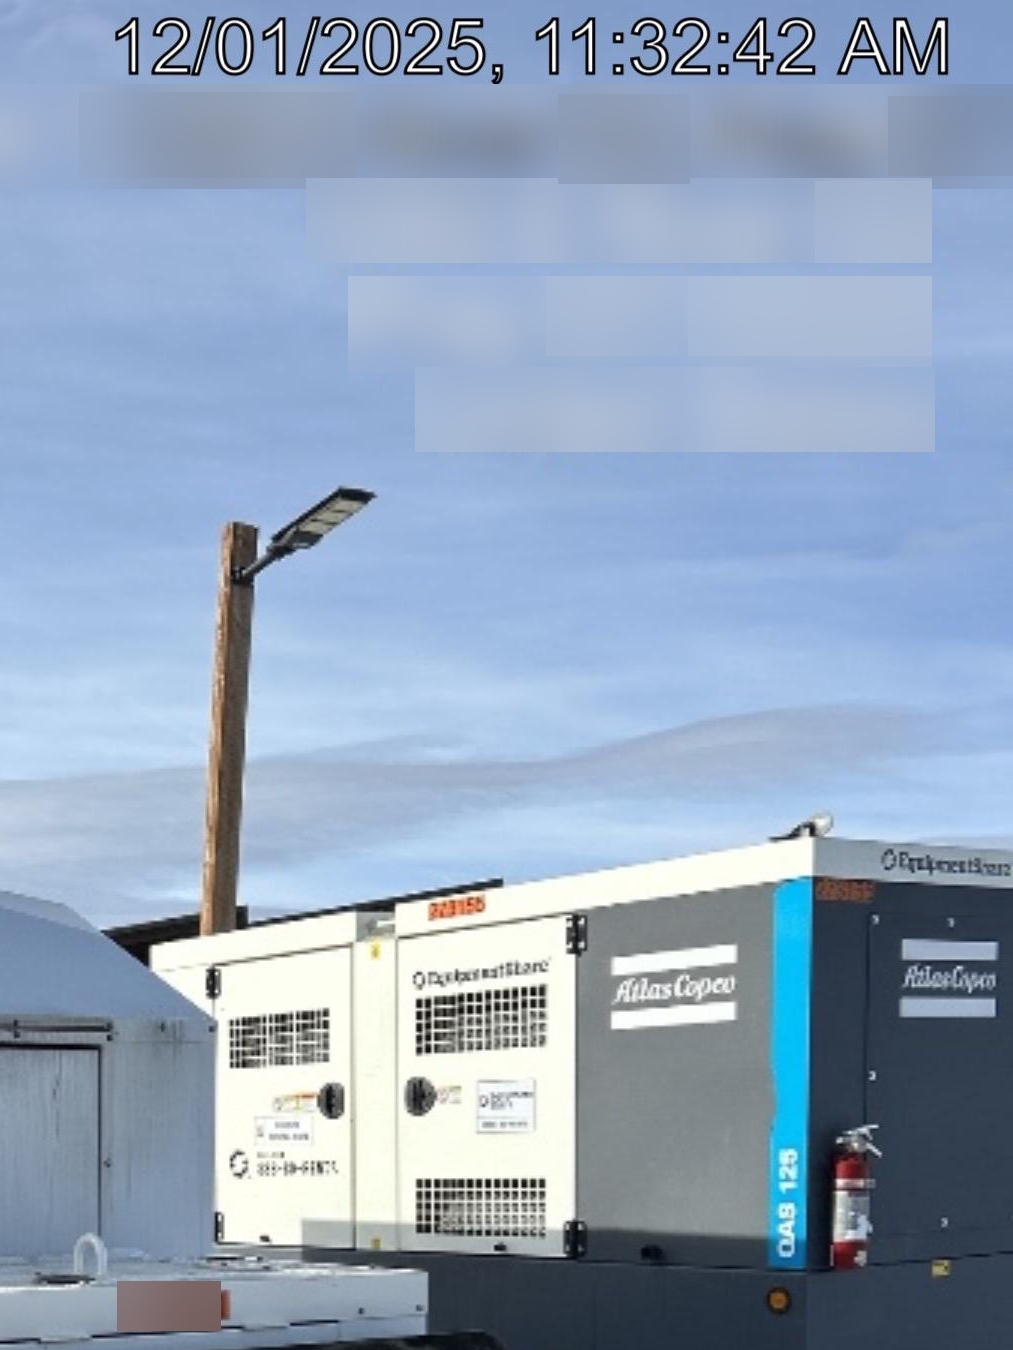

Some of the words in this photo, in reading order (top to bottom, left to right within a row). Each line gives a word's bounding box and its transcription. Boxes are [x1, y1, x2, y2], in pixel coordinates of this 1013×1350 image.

[612, 976, 672, 1005] Atlas
[674, 972, 736, 1003] Copco
[778, 1147, 799, 1196] 125
